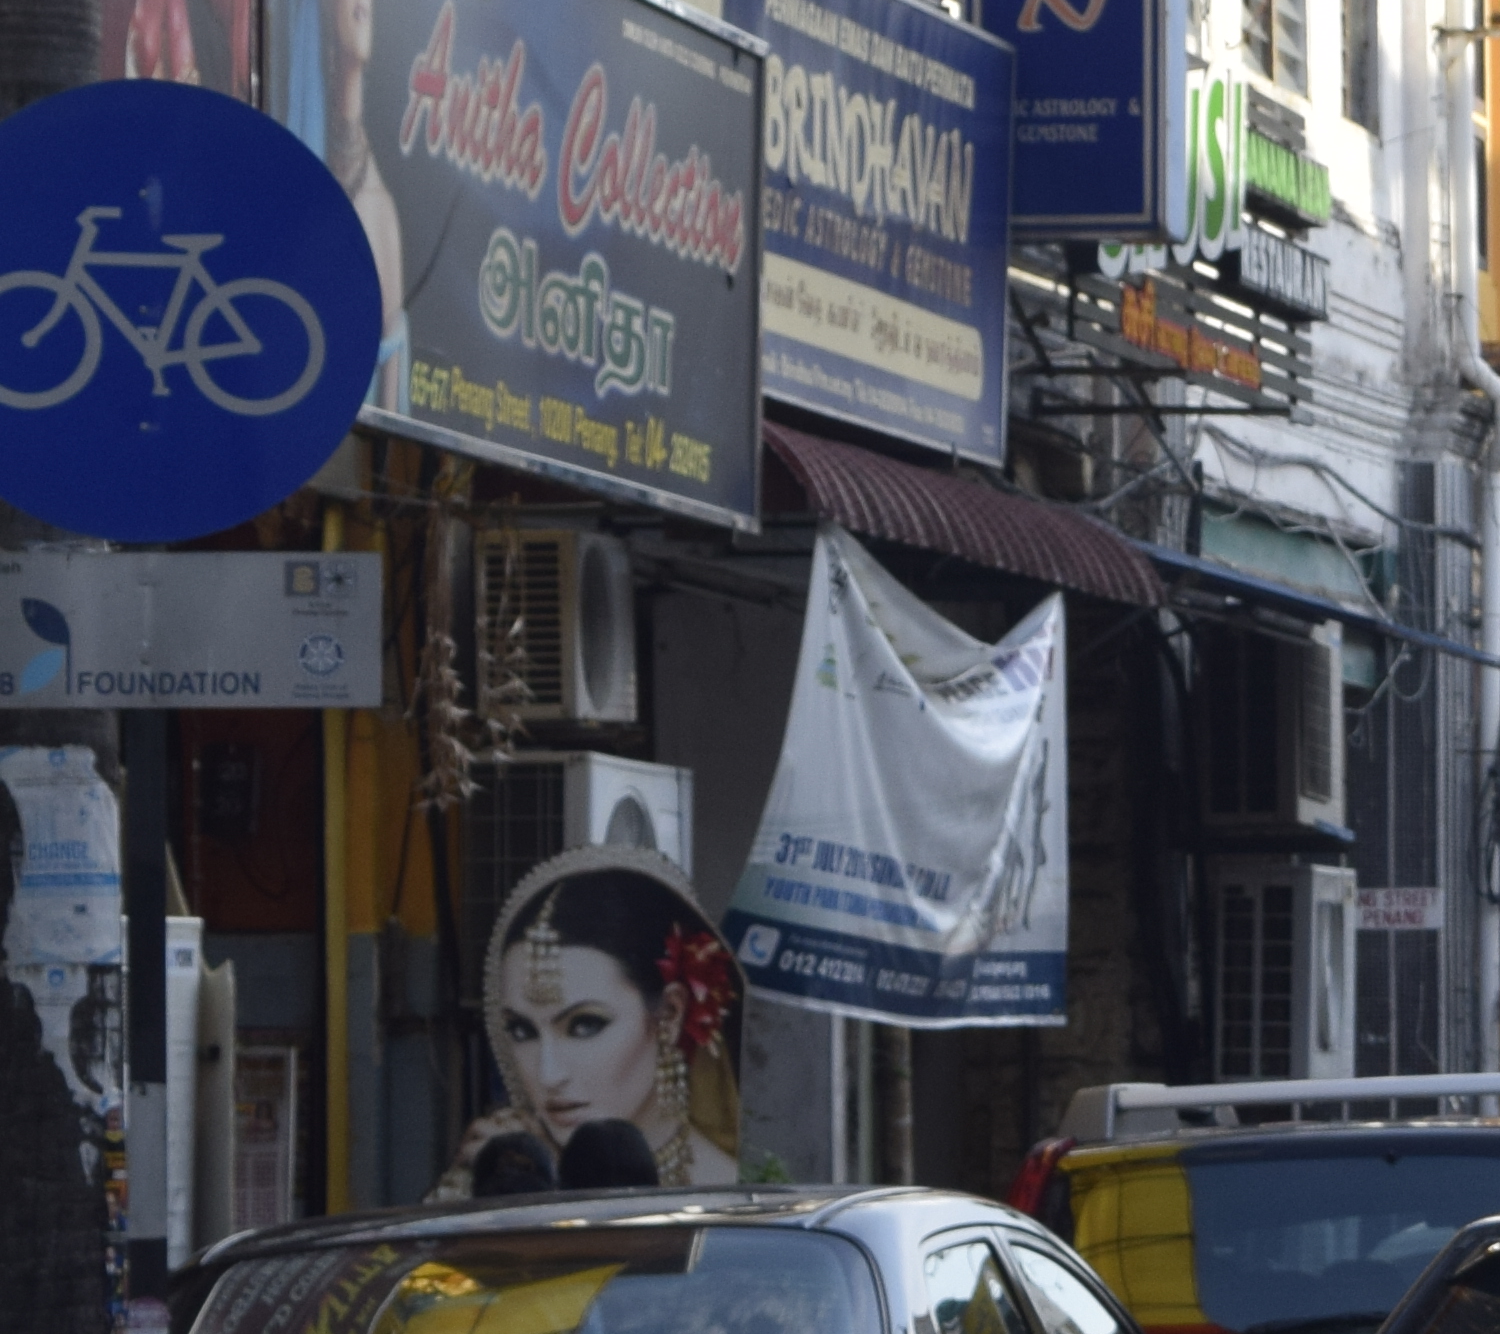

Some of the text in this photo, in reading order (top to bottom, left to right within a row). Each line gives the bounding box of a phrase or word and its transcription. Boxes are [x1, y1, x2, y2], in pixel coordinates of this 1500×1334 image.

[402, 0, 745, 273] Anitha Collection
[765, 53, 974, 245] BRINDHAVAN
[1017, 124, 1099, 142] GEMSTONE
[762, 185, 802, 238] EDIC
[480, 227, 677, 397] அனிதா
[77, 671, 261, 696] FOUNDATION
